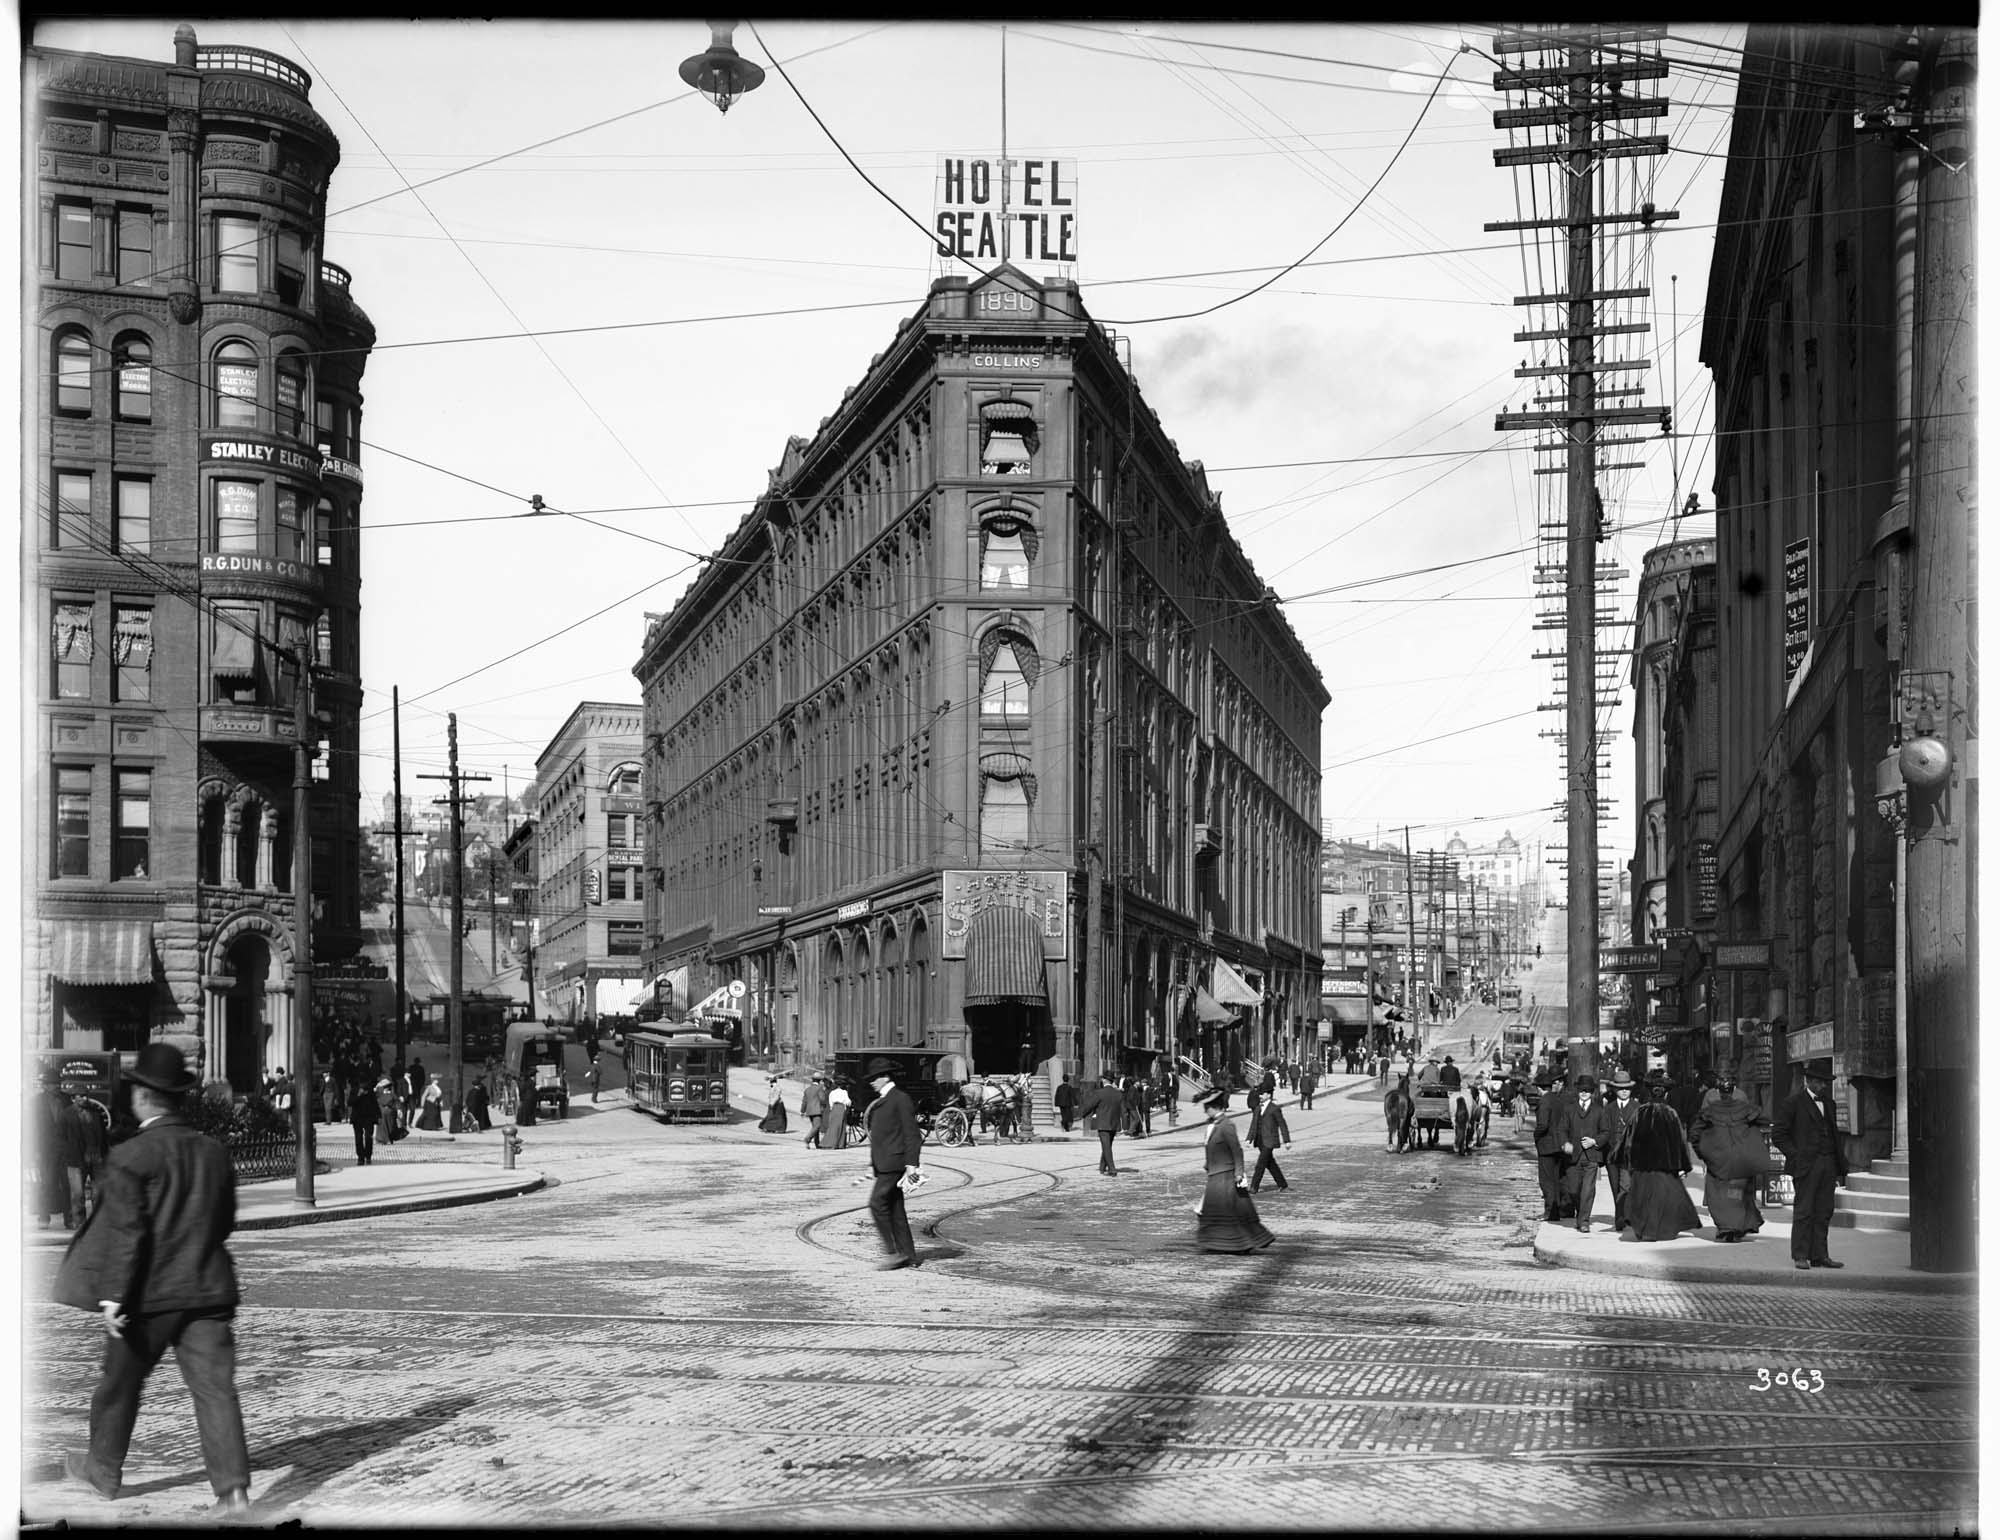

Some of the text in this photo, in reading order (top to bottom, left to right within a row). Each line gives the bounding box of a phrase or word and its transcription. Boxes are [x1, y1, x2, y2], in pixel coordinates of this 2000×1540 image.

[945, 158, 1072, 206] HOTEL
[936, 211, 1077, 262] SEATTLE
[979, 291, 1033, 312] 1890
[974, 356, 1041, 369] COLLINS
[211, 442, 274, 461] STANLEY
[265, 561, 273, 570] &
[967, 871, 1045, 893] HOTEL
[945, 890, 1063, 937] SEATTLE
